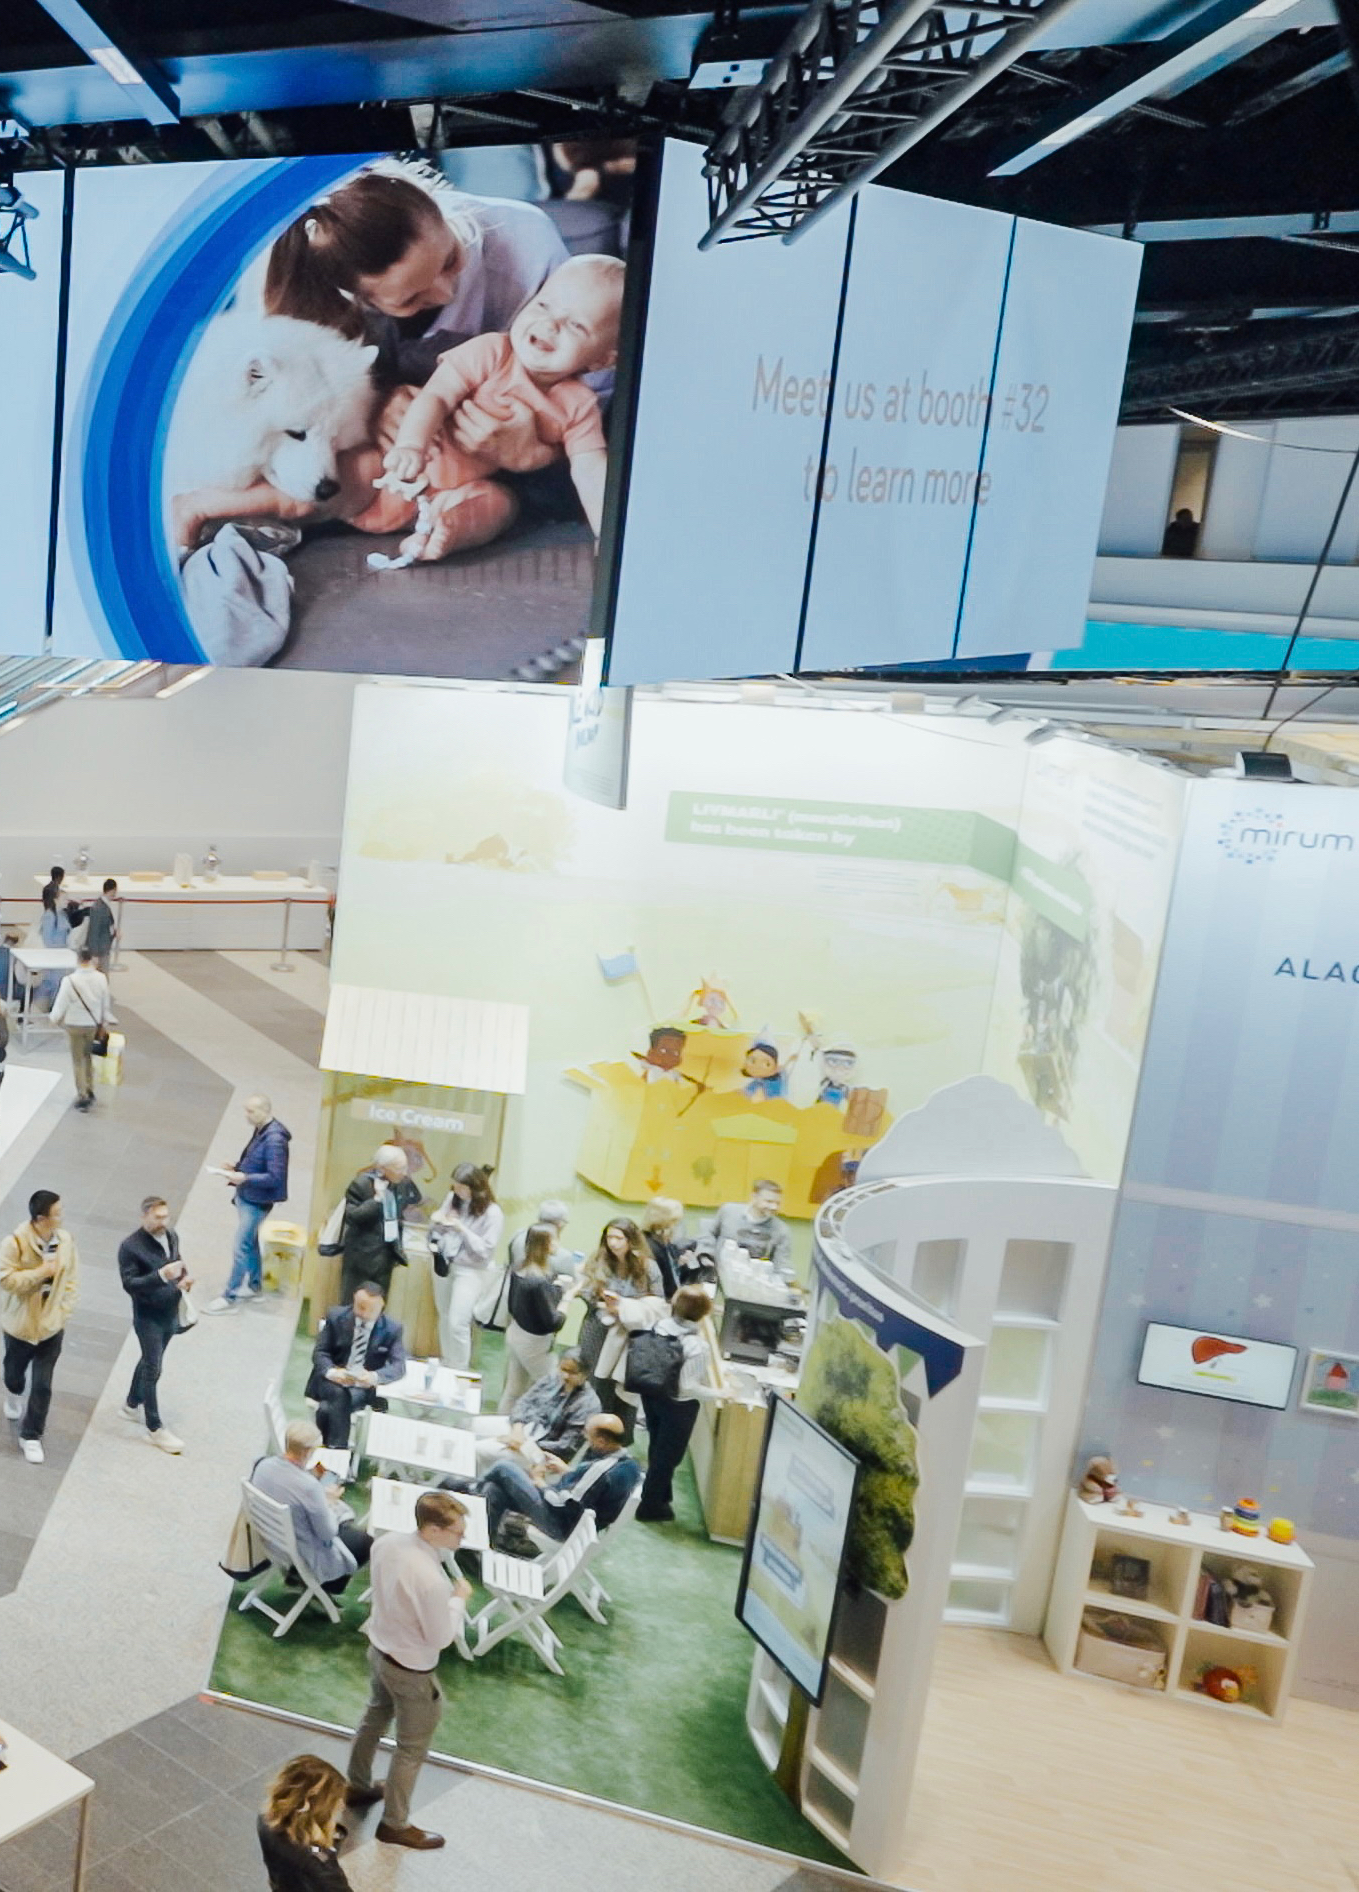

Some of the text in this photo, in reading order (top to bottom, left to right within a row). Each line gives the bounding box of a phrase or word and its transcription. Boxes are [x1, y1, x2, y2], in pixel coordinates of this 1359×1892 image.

[752, 354, 1050, 434] Meet us at booth #32
[848, 446, 916, 504] learn
[921, 467, 992, 506] more
[724, 822, 770, 838] been
[773, 827, 828, 843] taken
[831, 831, 857, 848] by
[1240, 822, 1354, 852] mirum
[368, 1102, 465, 1133] Ice Cream
